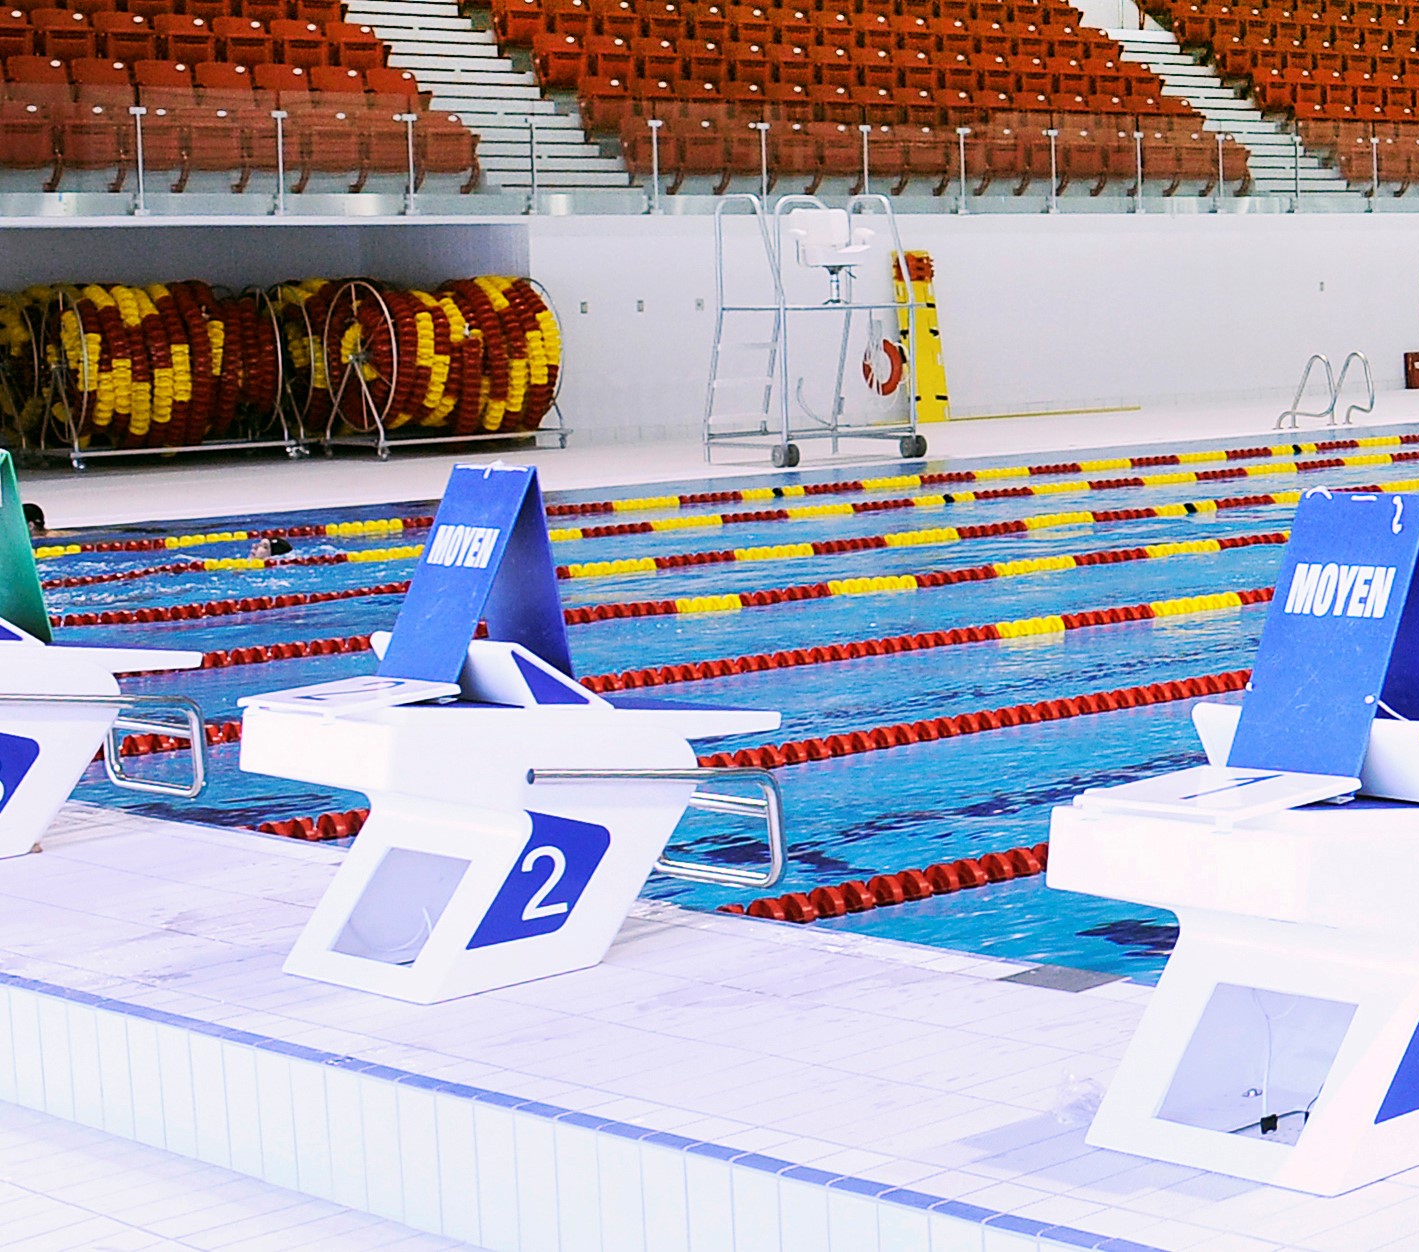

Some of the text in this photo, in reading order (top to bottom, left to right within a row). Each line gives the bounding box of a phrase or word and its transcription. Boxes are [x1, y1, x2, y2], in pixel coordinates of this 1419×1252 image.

[425, 524, 501, 569] MOYEN
[1283, 562, 1397, 619] MOYEN
[521, 845, 568, 921] 2
